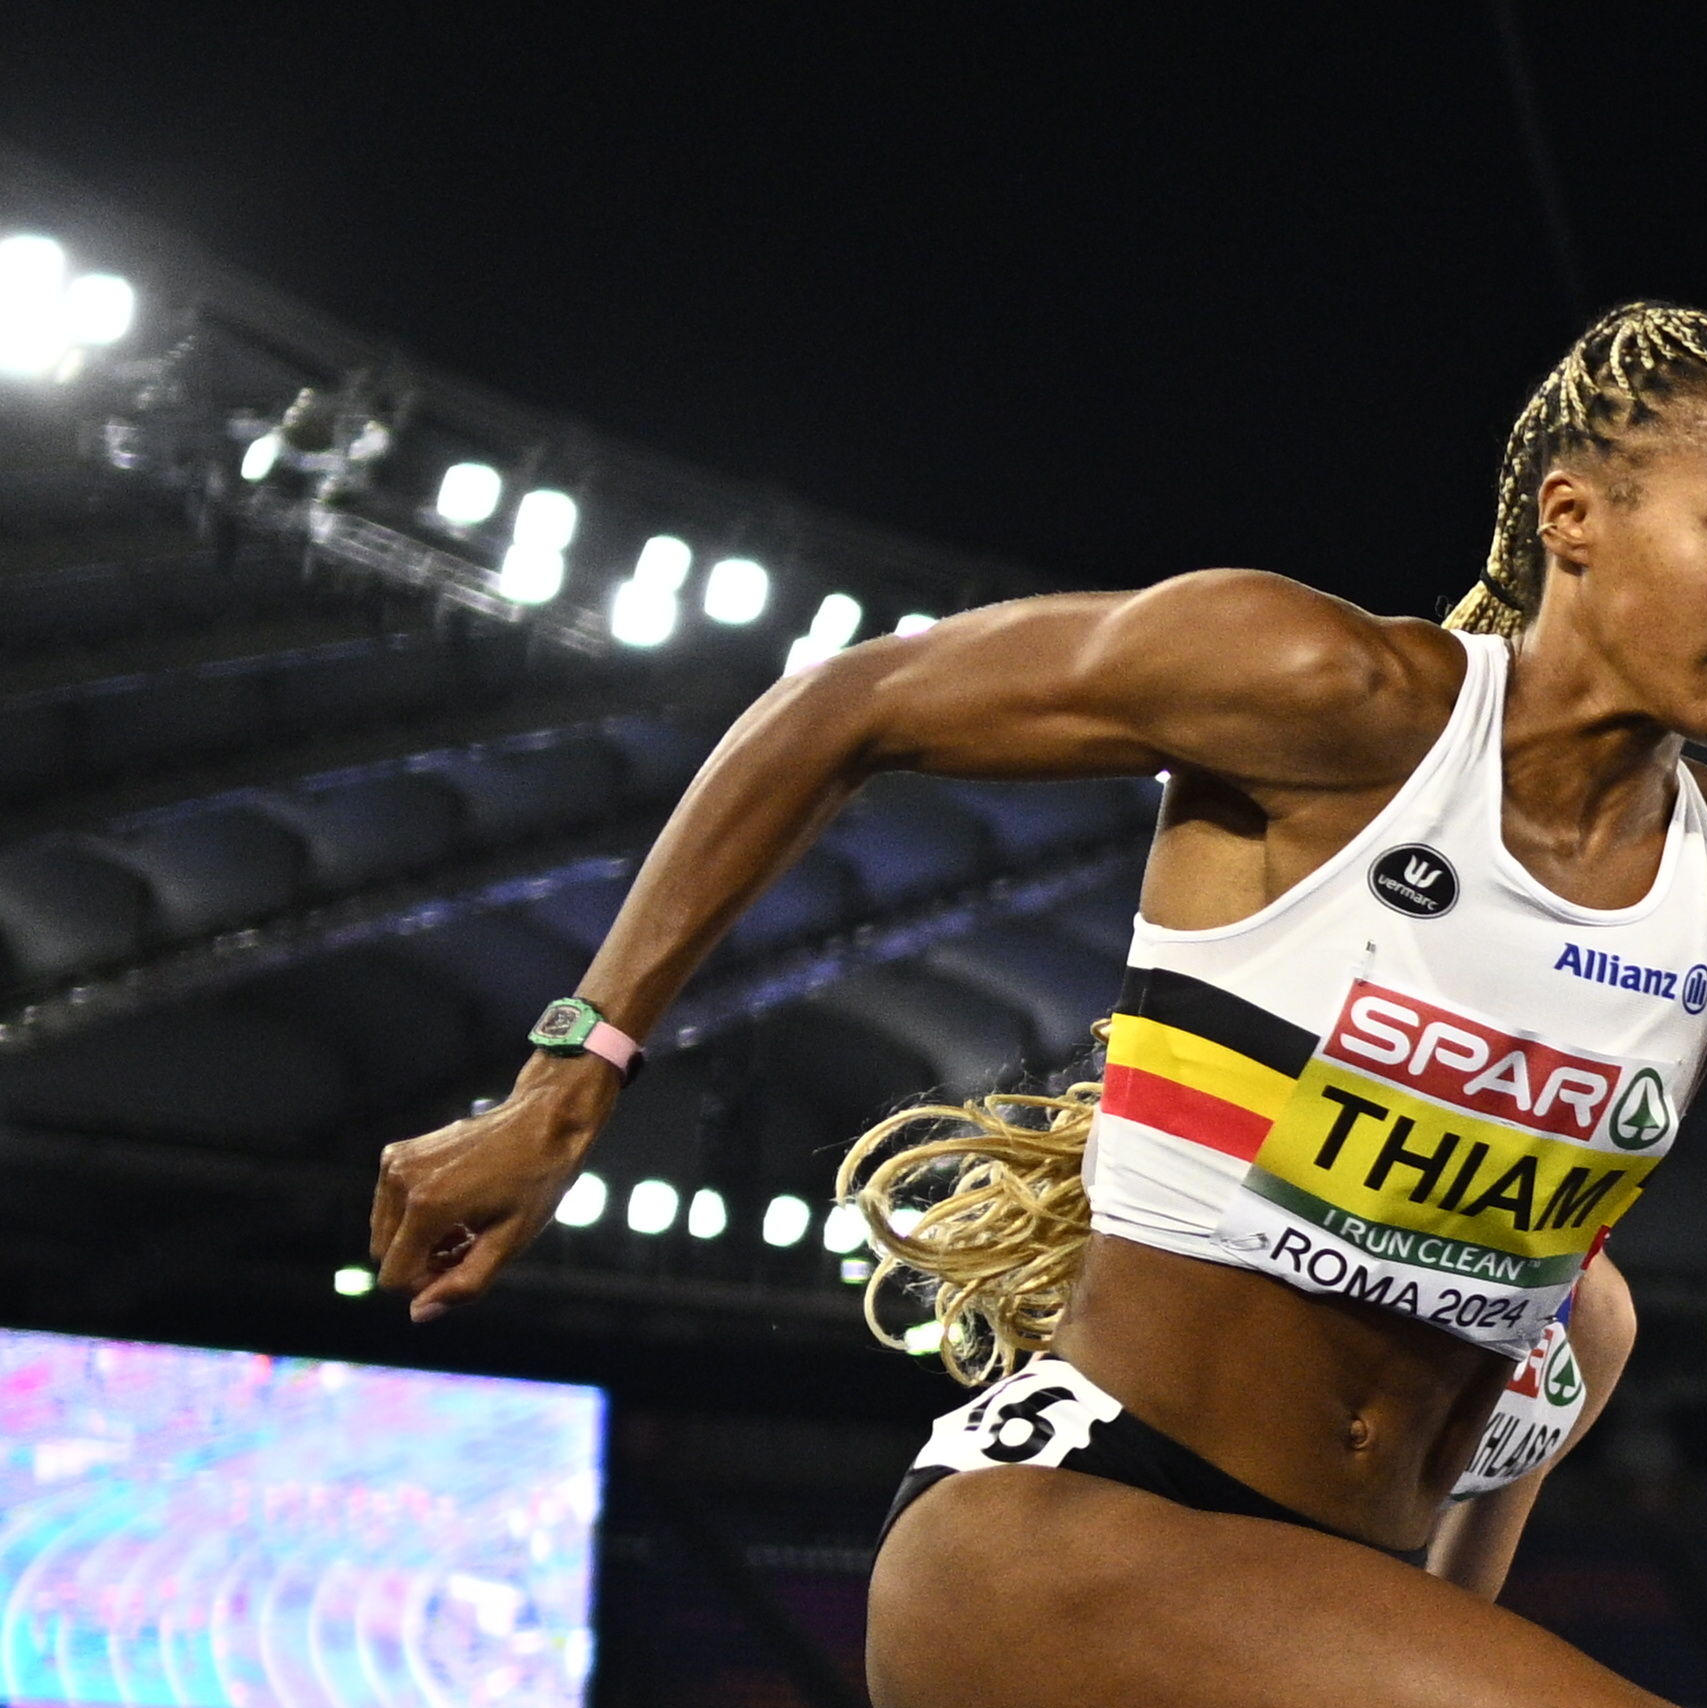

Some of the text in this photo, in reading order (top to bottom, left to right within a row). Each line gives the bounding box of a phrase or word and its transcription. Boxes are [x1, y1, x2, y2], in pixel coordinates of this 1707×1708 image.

[1378, 874, 1439, 911] vermarc
[1553, 942, 1678, 1000] Allianz
[1340, 996, 1608, 1127] SPAR
[1314, 1084, 1628, 1232] THIAM
[1322, 1208, 1338, 1227] I
[1340, 1216, 1414, 1258] RUN
[1270, 1227, 1530, 1328] ROMA 2024
